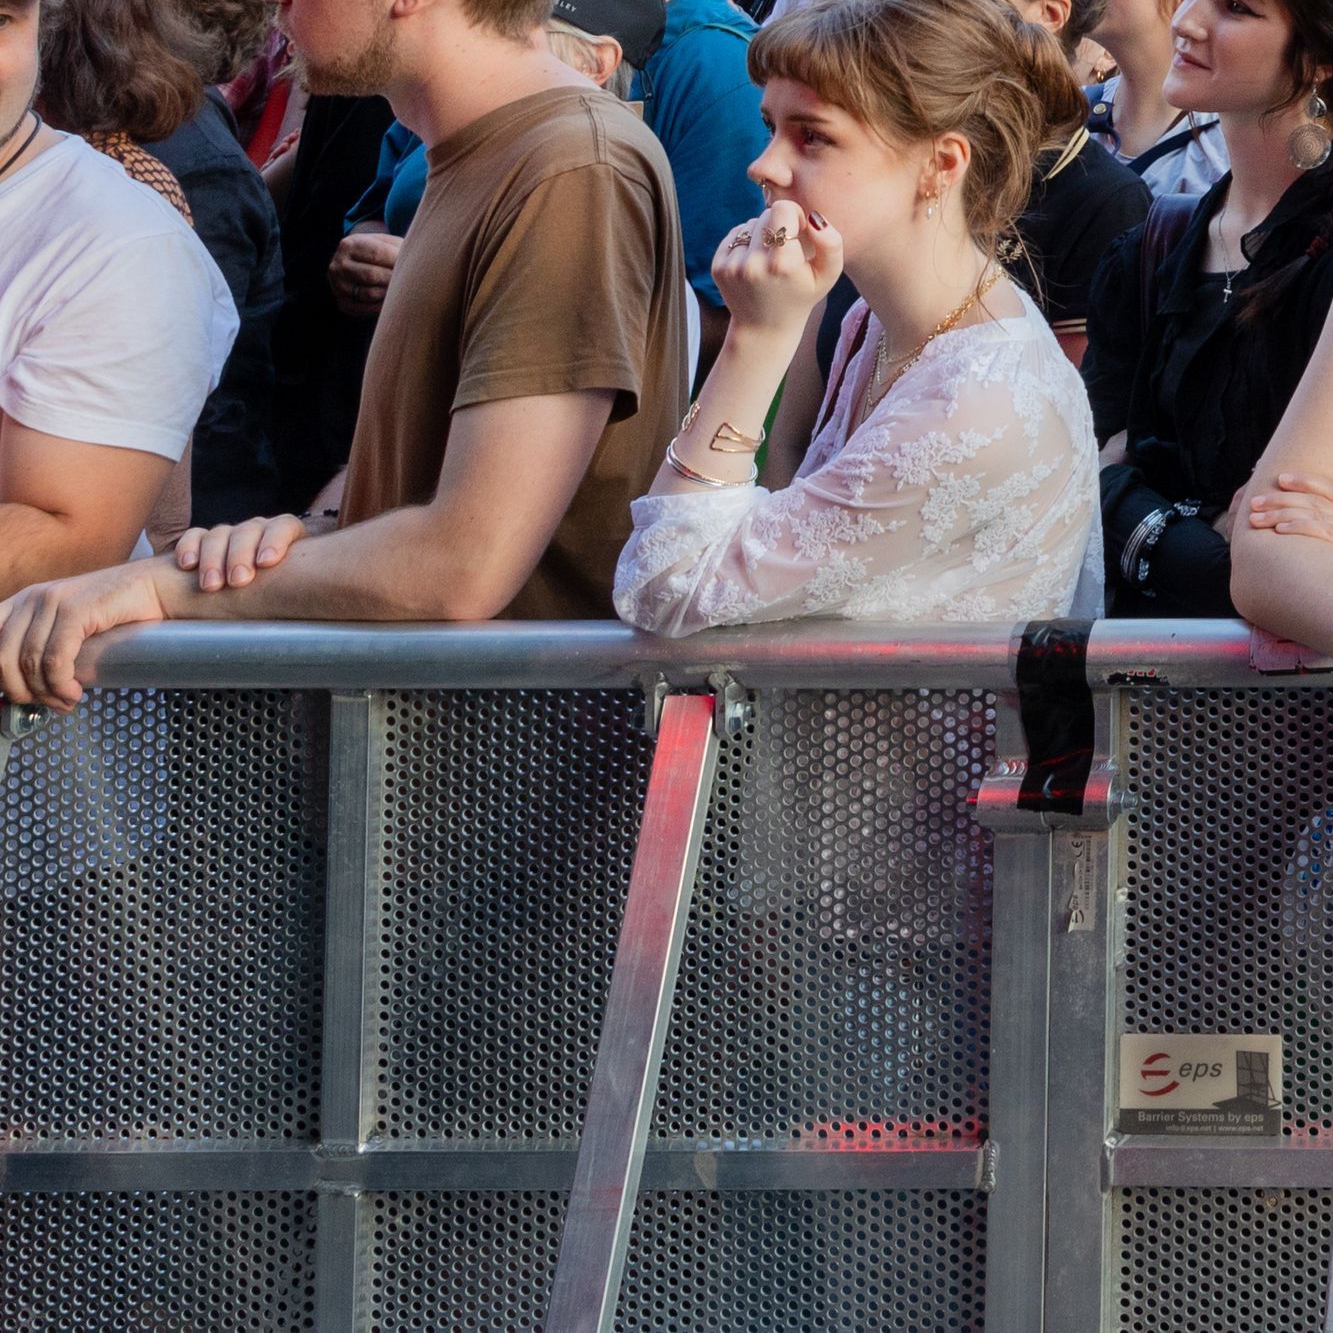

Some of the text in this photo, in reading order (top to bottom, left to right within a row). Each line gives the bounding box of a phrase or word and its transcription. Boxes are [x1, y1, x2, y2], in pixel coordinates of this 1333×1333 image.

[1178, 1062, 1223, 1082] eps
[1138, 1111, 1264, 1125] Barrier Systems by eps
